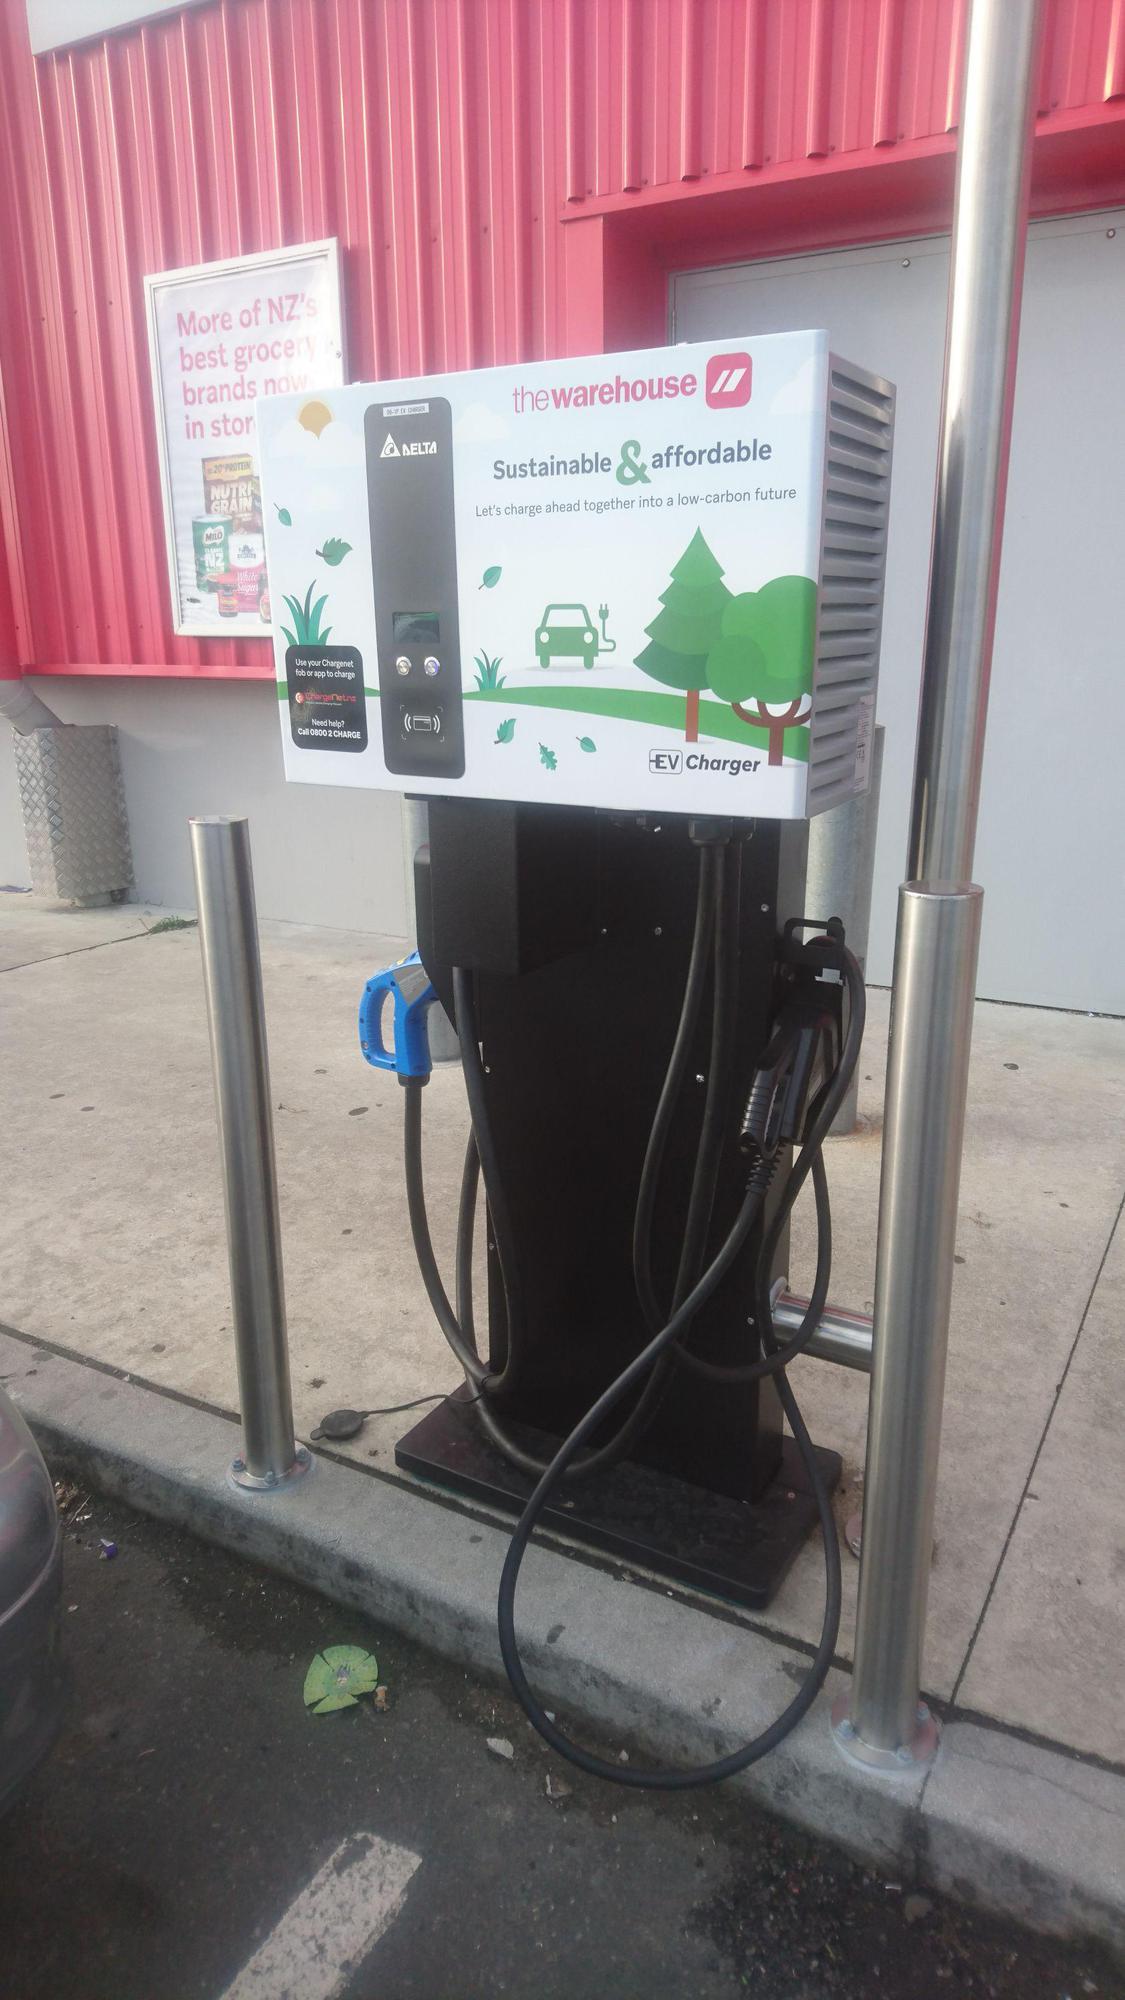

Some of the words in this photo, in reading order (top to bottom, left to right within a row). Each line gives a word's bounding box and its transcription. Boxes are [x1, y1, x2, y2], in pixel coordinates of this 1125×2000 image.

[177, 310, 233, 337] More
[239, 298, 262, 328] of
[267, 293, 318, 325] NZ's
[180, 343, 228, 372] best
[234, 336, 316, 373] grocery
[182, 375, 257, 406] brands
[264, 375, 308, 396] now
[185, 413, 205, 440] in
[211, 413, 256, 438] stor
[402, 441, 437, 456] DELTA
[493, 451, 612, 480] Sustainable
[615, 439, 652, 486] &
[651, 438, 772, 469] affordable
[210, 497, 253, 513] GRAIN
[475, 504, 501, 517] Let's
[504, 502, 542, 518] charge
[545, 500, 580, 514] ahead
[583, 498, 635, 514] together
[638, 496, 663, 509] into
[666, 497, 675, 507] a
[677, 490, 751, 506] low-carbon
[754, 487, 797, 502] future
[205, 531, 223, 541] MILO
[308, 660, 321, 668] your
[295, 669, 306, 677] fob
[334, 671, 355, 680] charge
[312, 719, 327, 727] Need
[329, 719, 345, 728] help?
[298, 728, 309, 736] Call
[310, 729, 327, 737] 0800
[333, 731, 361, 739] CHARGE
[655, 754, 680, 770] EV
[686, 754, 761, 776] Charger
